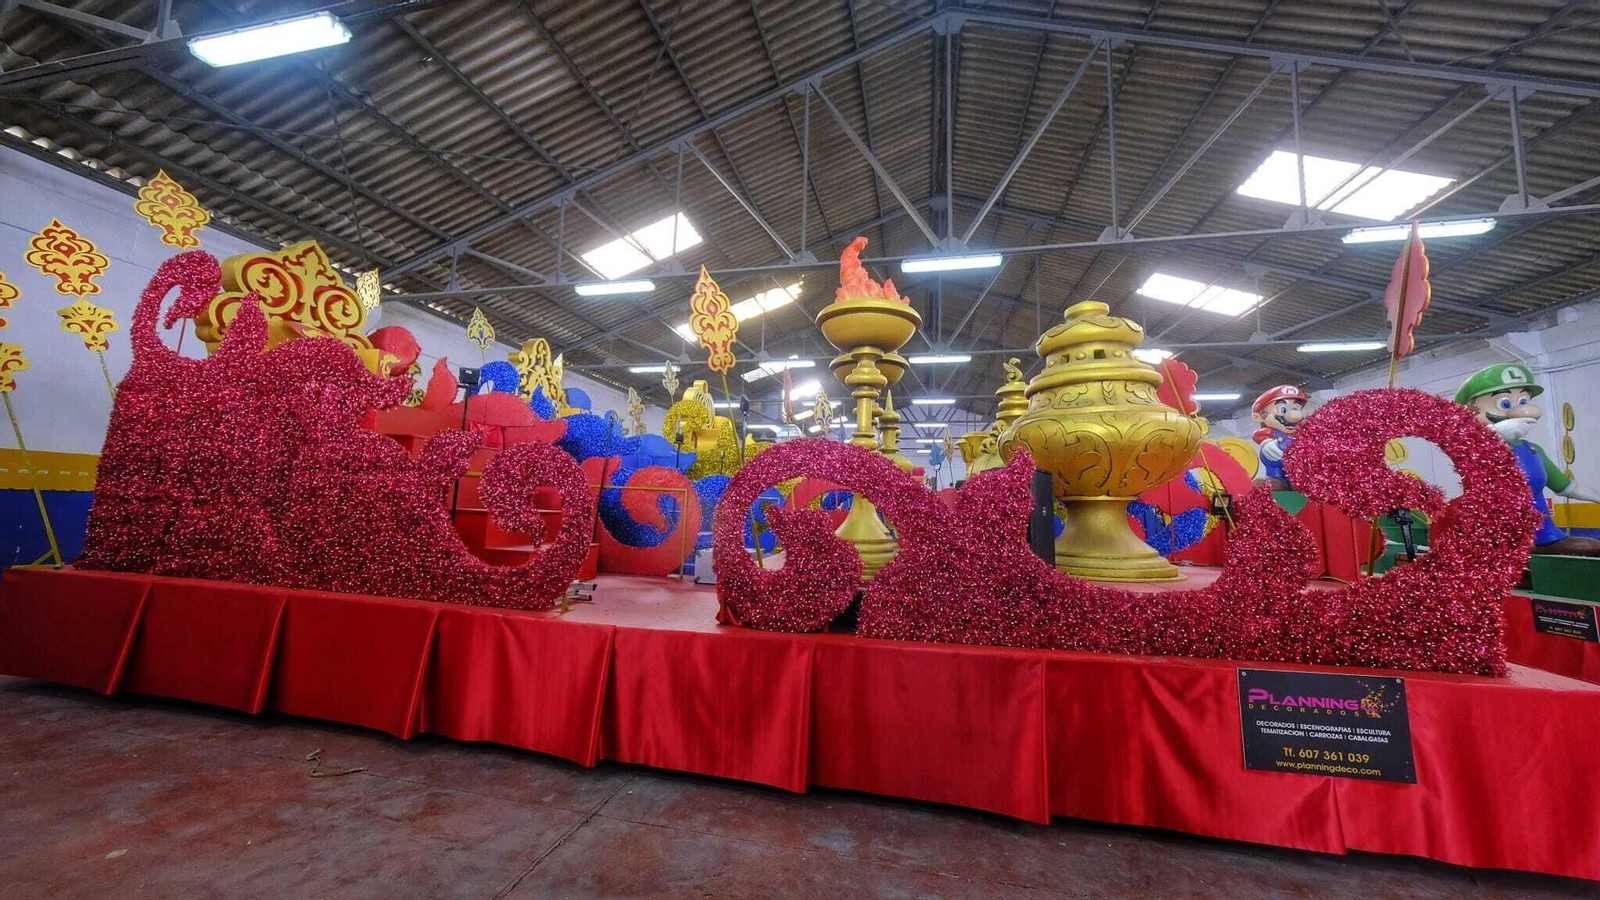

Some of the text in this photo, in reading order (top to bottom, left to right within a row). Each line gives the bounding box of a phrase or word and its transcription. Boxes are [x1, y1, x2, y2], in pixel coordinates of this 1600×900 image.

[1508, 370, 1522, 380] L
[1286, 387, 1297, 395] M
[1248, 688, 1360, 711] PLANNING
[1248, 703, 1360, 717] DECORADOS
[1256, 720, 1391, 737] DECORADOS ESCENOGRAFIAS ESCULTURA
[1261, 727, 1389, 743] TEMATIZACION CARROZAS CABALGATAS
[1282, 747, 1370, 763] Tf. 607 361 039
[1275, 760, 1382, 776] www.planningdeco.com
